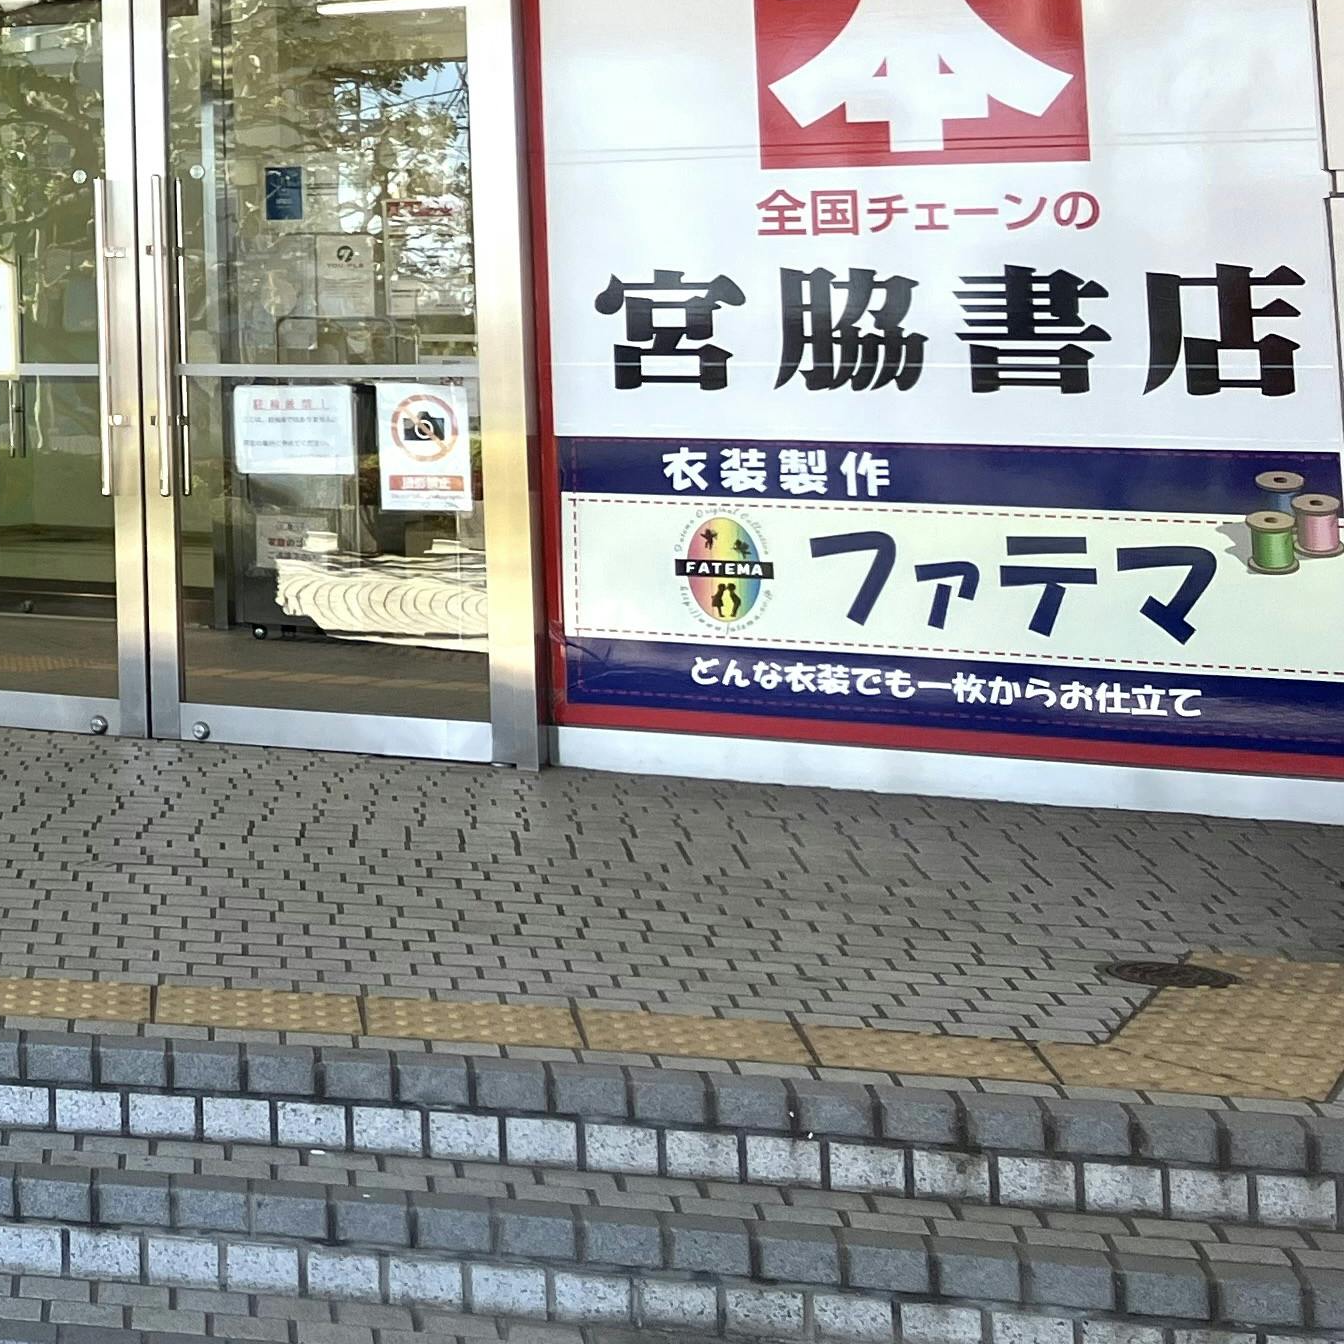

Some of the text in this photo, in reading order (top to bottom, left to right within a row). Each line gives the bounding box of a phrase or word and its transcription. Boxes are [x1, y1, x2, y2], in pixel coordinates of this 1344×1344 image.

[756, 189, 1101, 237] 全国チェーンの
[594, 263, 1307, 397] 宮脇書店
[662, 446, 891, 497] 衣装製作
[686, 561, 764, 576] FATEMA
[809, 529, 1218, 646] ファテマ
[688, 655, 1203, 718] どんな衣装でも一枚からお仕立て
